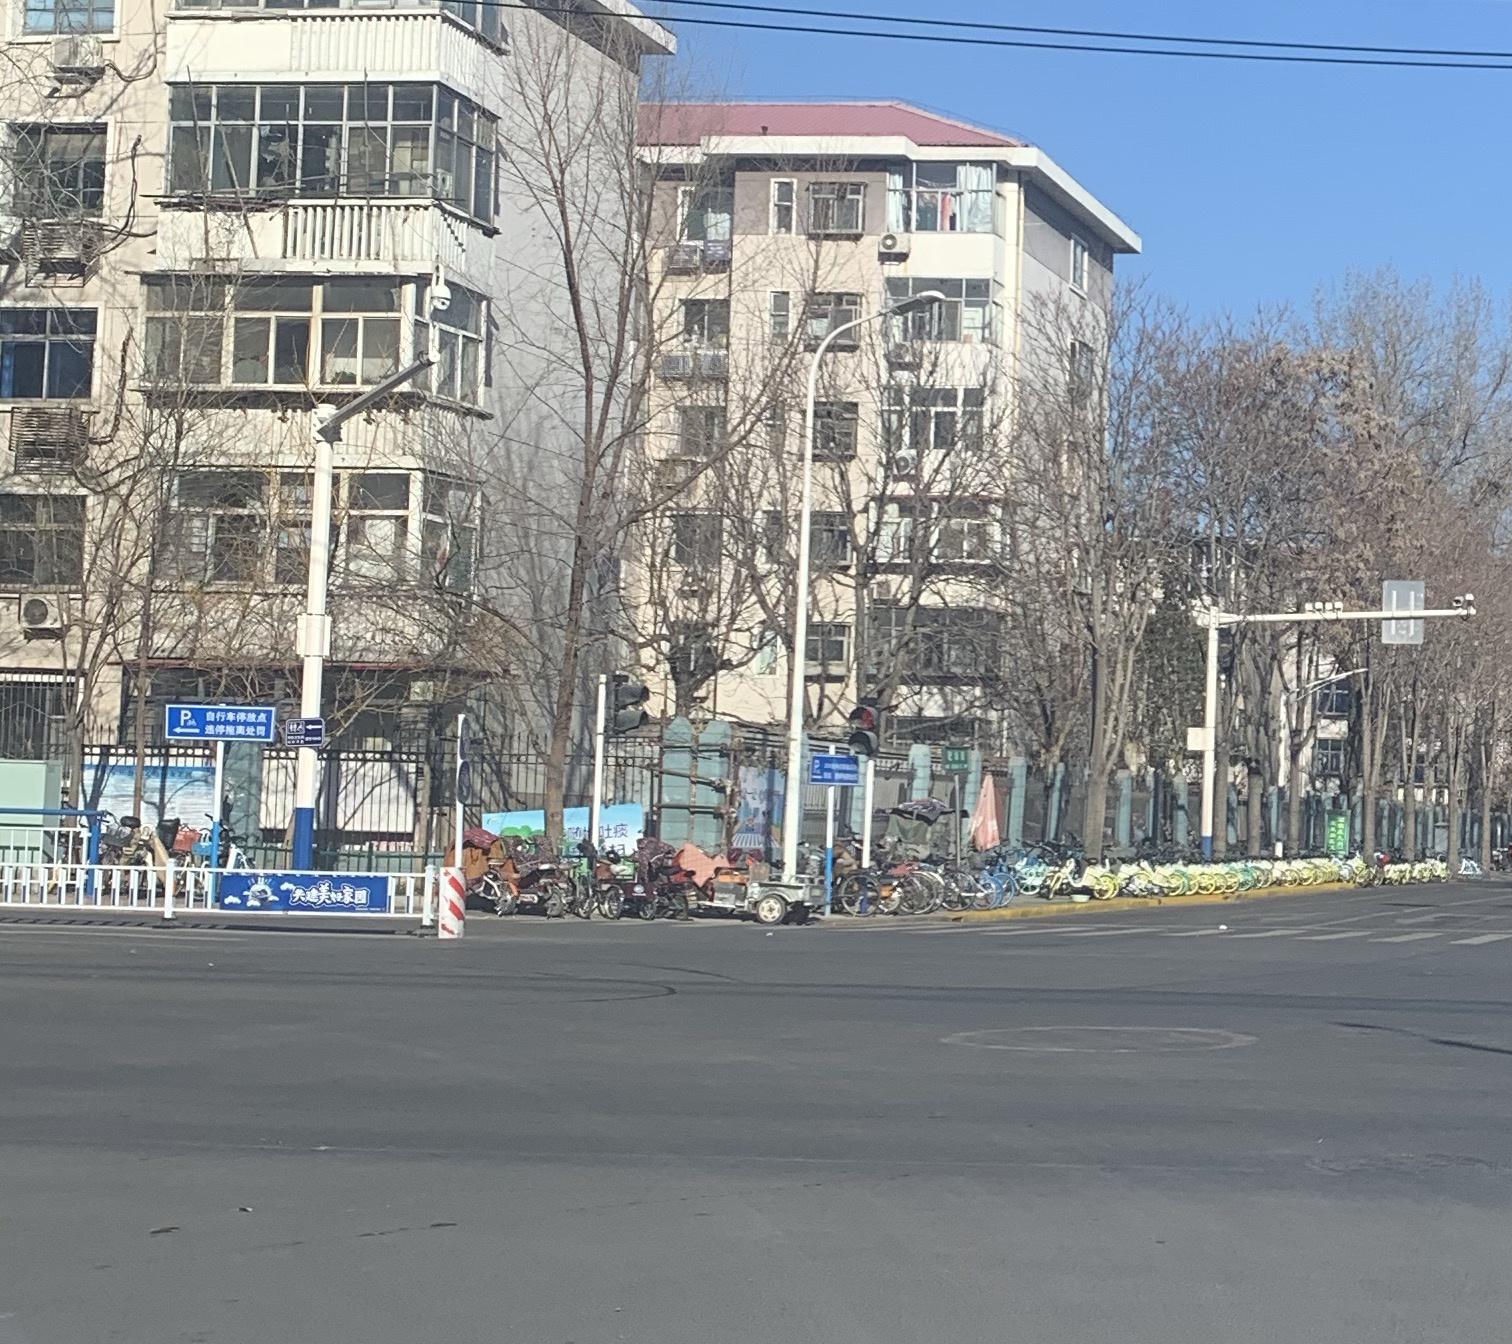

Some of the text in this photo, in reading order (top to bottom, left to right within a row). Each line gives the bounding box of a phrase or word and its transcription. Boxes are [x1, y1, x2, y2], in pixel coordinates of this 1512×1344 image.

[205, 711, 267, 723] 自行车停放点
